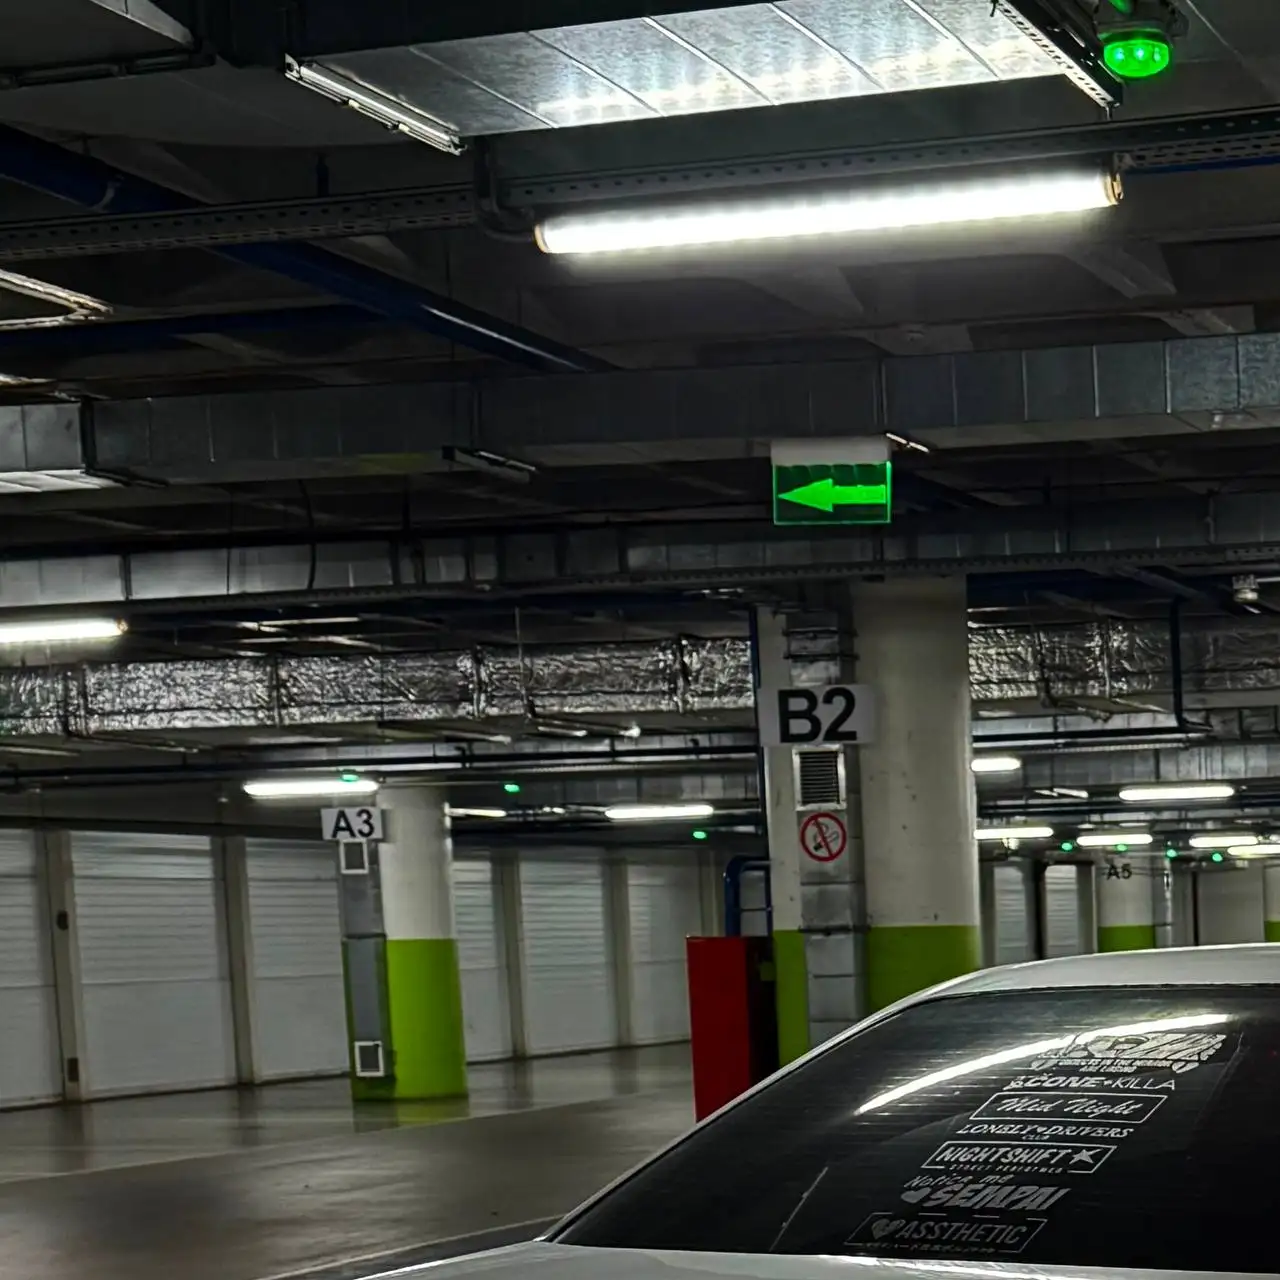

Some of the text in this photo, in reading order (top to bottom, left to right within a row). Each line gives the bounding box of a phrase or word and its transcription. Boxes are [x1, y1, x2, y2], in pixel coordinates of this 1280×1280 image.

[778, 687, 858, 744] B2
[331, 810, 375, 838] A3
[1106, 864, 1132, 880] A5
[1112, 1077, 1175, 1090] KILLA
[996, 1098, 1143, 1118] Mid Night
[956, 1124, 1134, 1138] LONELY DRIVERS
[936, 1147, 1072, 1164] NIGHTSHIFT
[979, 1174, 1015, 1184] me
[895, 1220, 1027, 1244] ASSTHETIC
